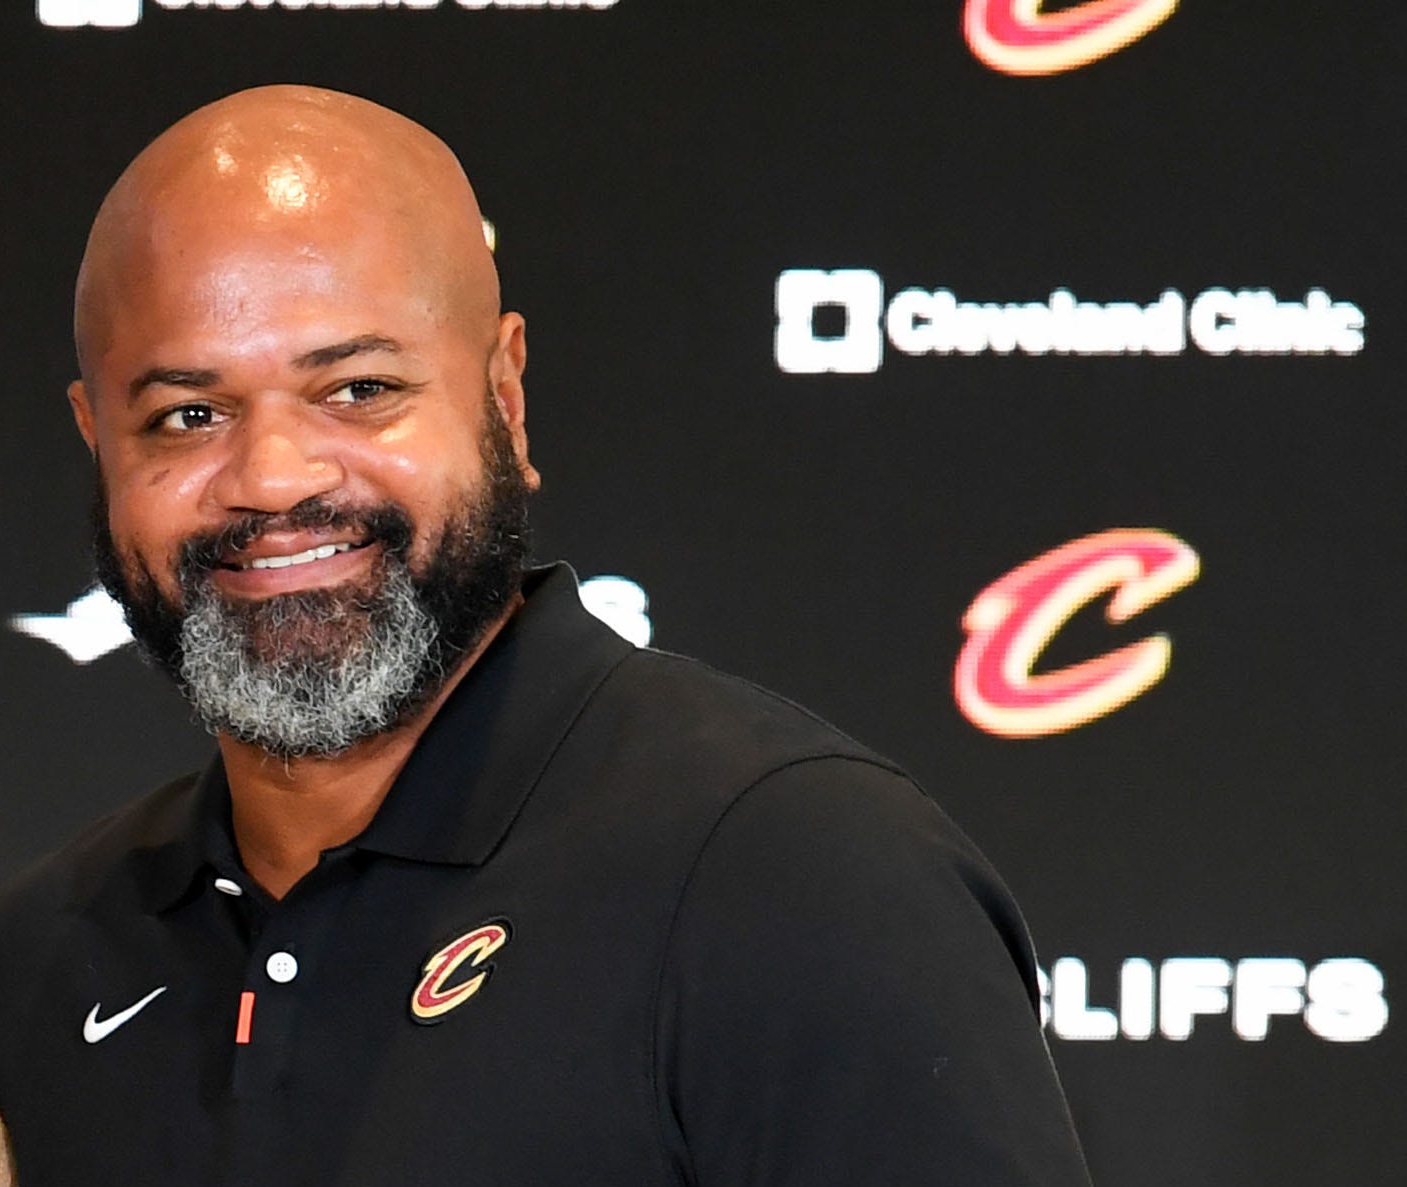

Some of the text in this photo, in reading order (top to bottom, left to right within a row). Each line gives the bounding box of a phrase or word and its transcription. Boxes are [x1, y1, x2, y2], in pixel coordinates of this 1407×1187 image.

[887, 287, 1365, 356] Cleveland Clinic
[952, 528, 1200, 739] C
[1037, 957, 1389, 1042] LIFFS
